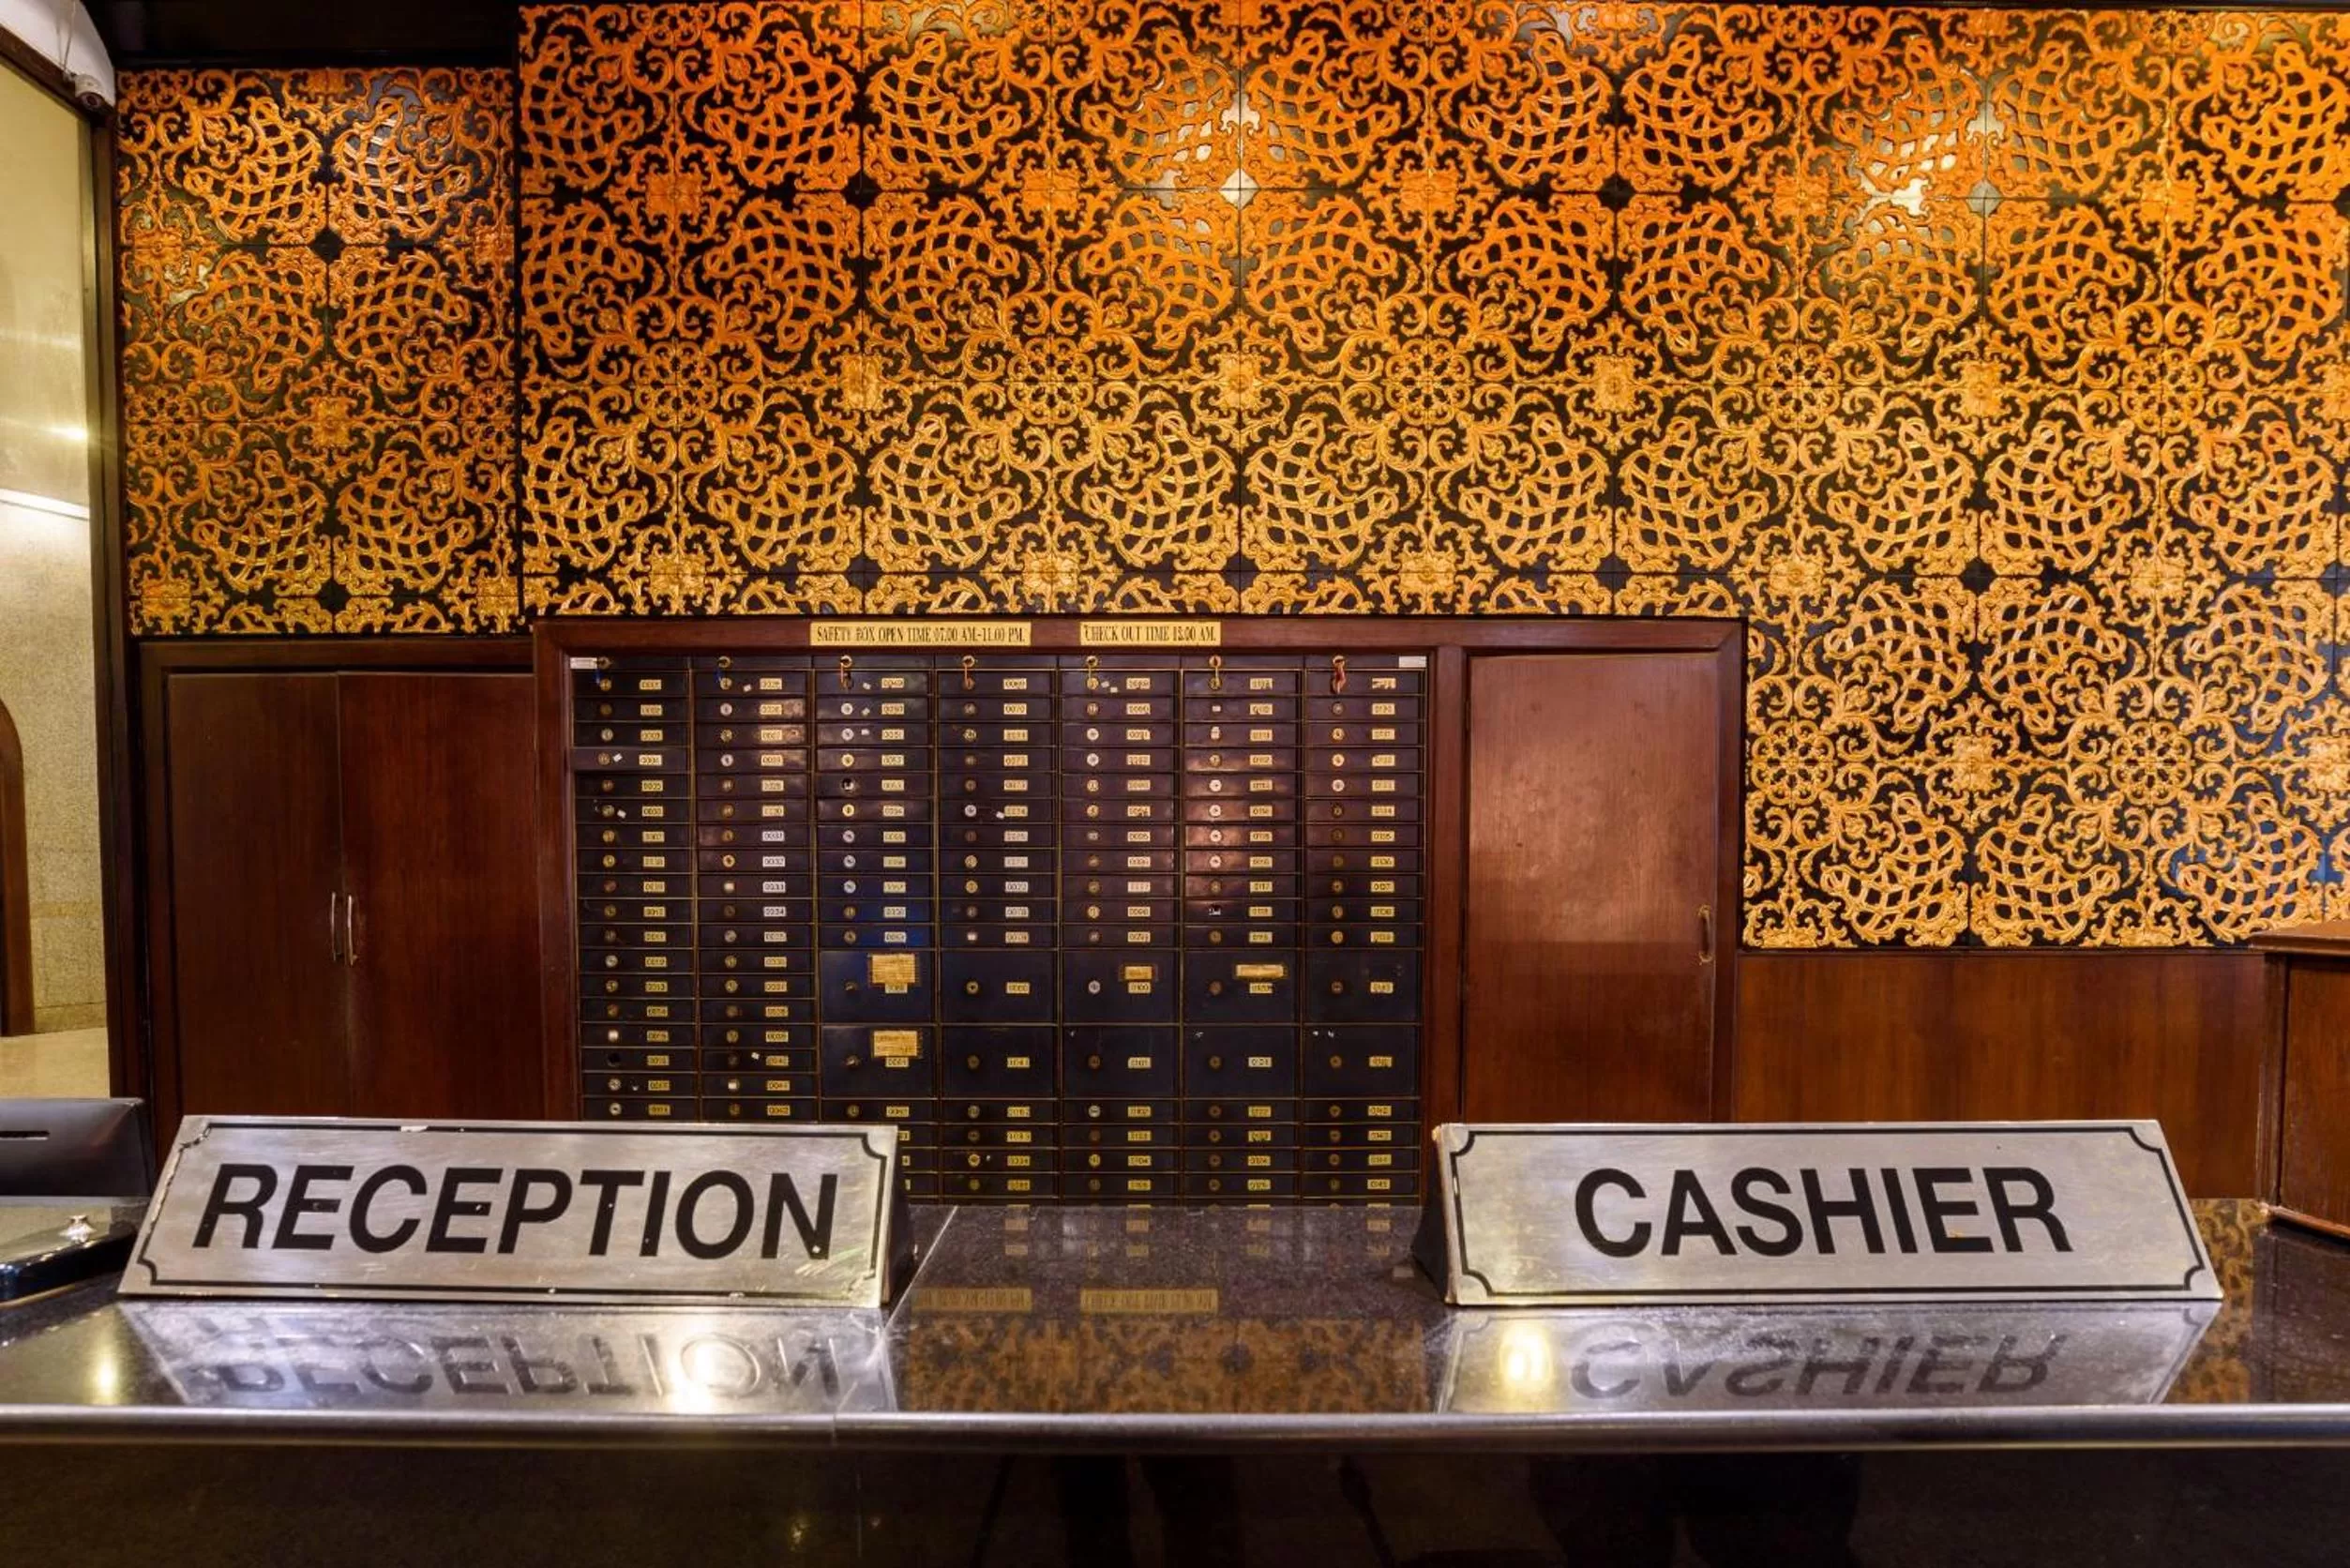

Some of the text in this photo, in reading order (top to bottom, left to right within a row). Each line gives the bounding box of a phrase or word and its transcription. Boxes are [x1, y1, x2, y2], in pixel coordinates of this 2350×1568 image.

[817, 626, 851, 642] SAFETY
[878, 626, 904, 642] OPEN
[907, 626, 931, 642] TIME
[1083, 625, 1118, 641] CHECK
[1121, 626, 1141, 641] OUT
[1146, 626, 1169, 641] TIME
[193, 1164, 836, 1259] RECEPTION
[1576, 1168, 2071, 1257] CASHIER
